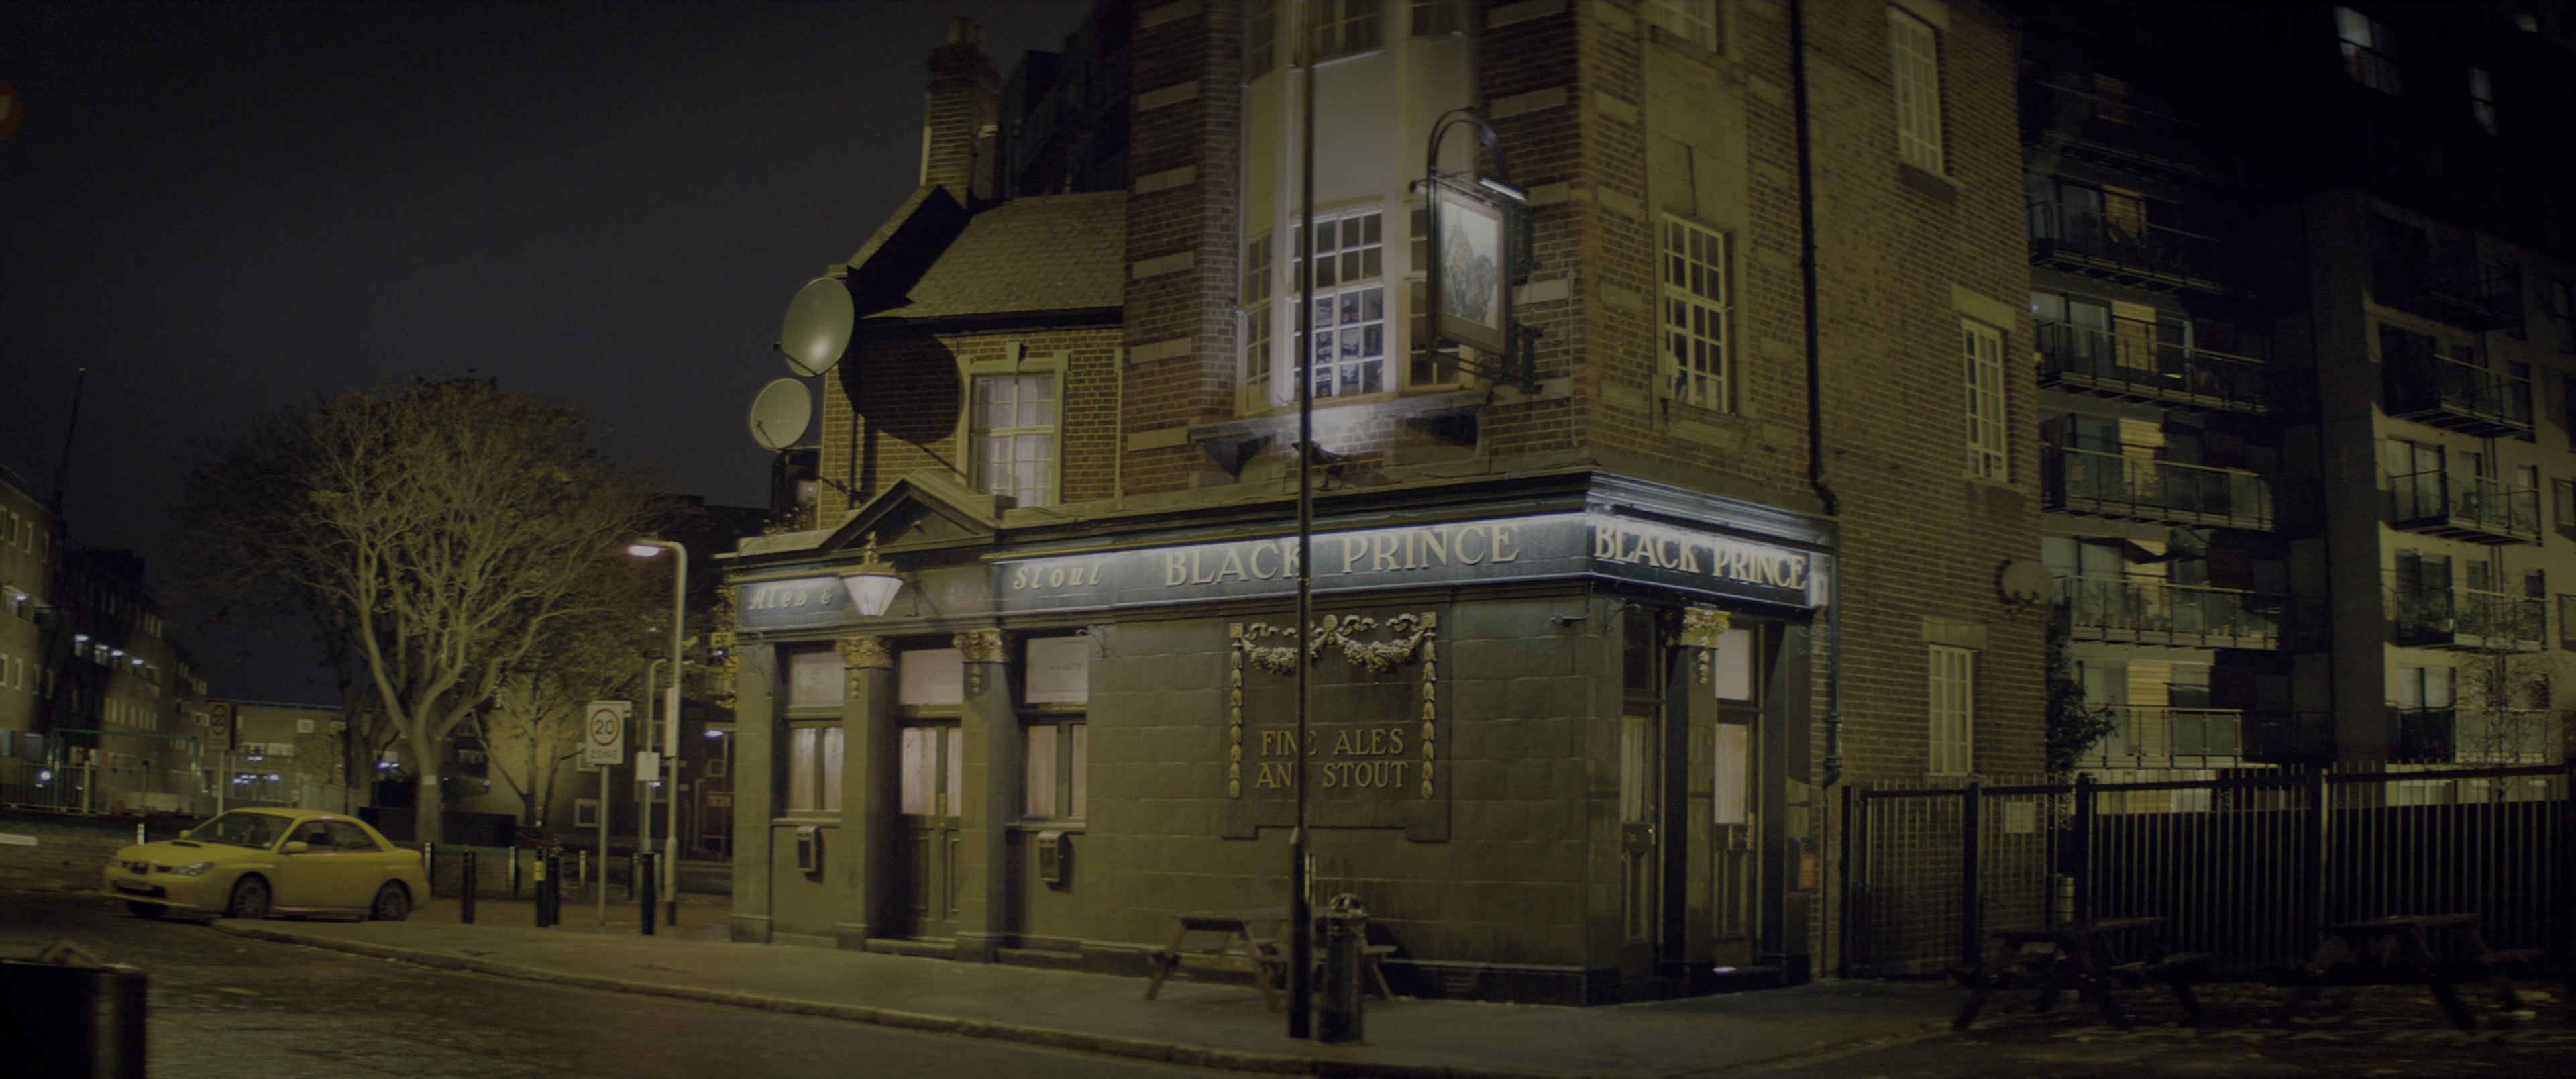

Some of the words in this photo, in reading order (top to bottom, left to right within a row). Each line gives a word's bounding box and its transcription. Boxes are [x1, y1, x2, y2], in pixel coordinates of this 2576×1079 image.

[1164, 542, 1301, 587] BLACK
[1342, 525, 1521, 573] PRINCE
[1594, 521, 1701, 573] BLACK
[1711, 543, 1808, 590] PRINCE
[1013, 564, 1102, 590] Stout
[747, 588, 808, 611] Ales
[595, 719, 615, 735] 20
[590, 749, 618, 760] ZONE
[1261, 730, 1318, 756] FINE
[1332, 727, 1403, 756] ALES
[1255, 761, 1297, 788] AN
[1322, 760, 1408, 788] STOUT
